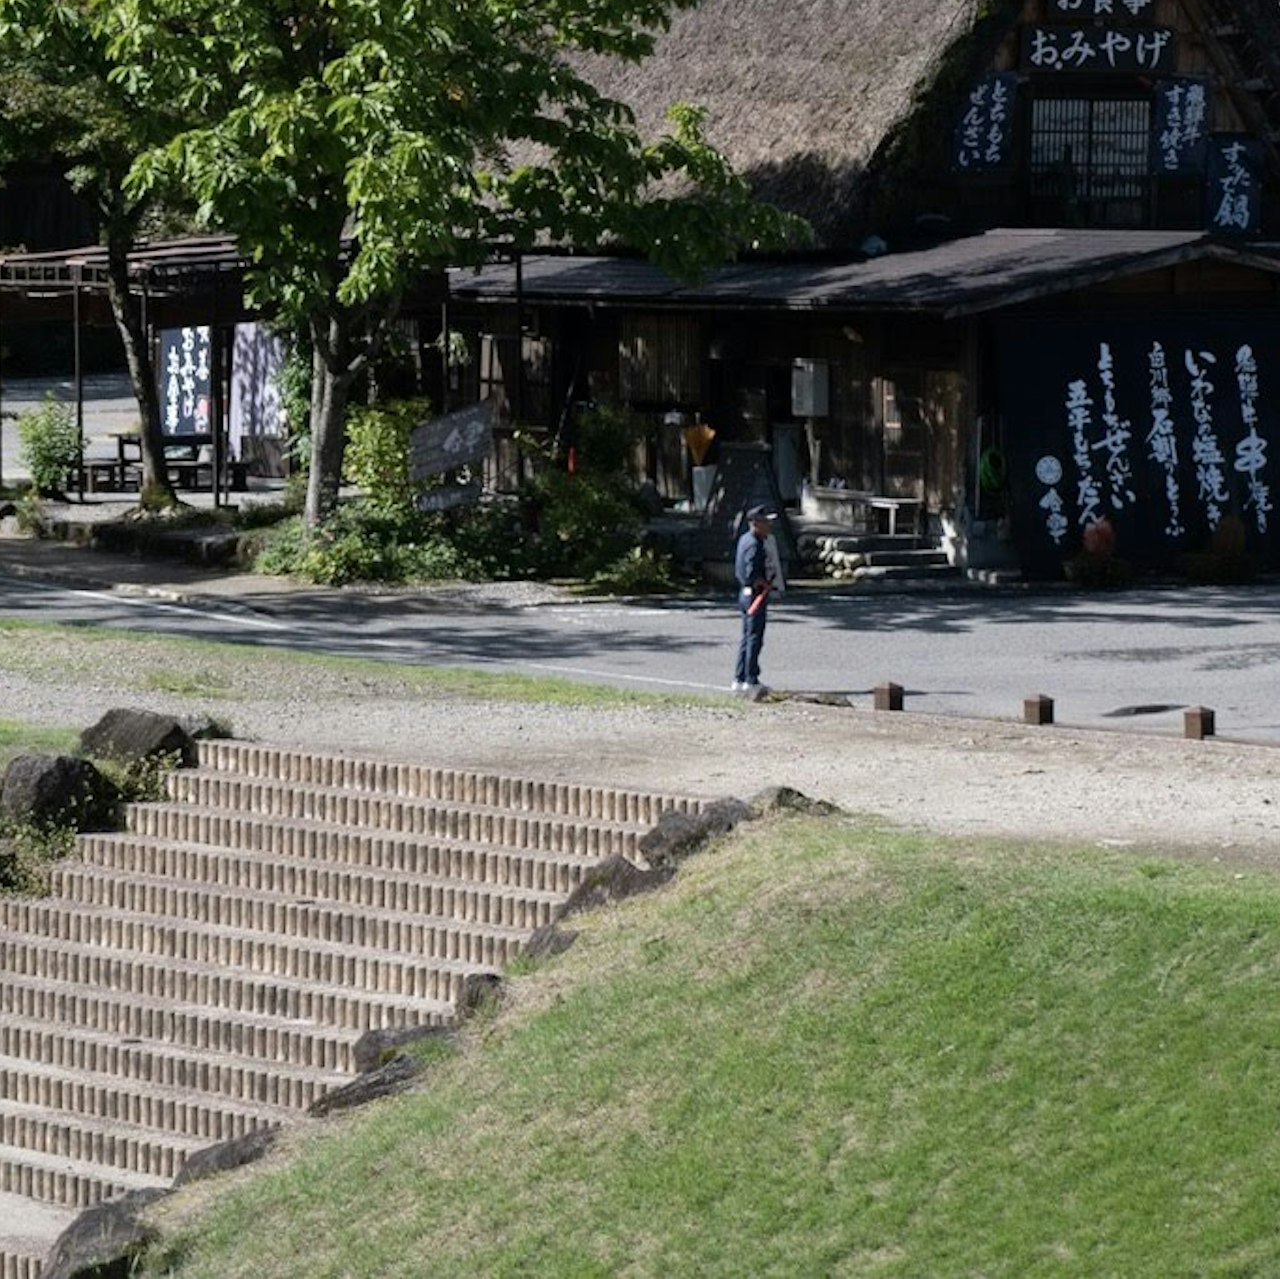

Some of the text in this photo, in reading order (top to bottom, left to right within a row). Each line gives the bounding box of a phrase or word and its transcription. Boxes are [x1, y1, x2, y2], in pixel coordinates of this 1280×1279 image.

[1029, 28, 1173, 69] おみやげ
[958, 83, 990, 167] ぜんざい
[984, 79, 1008, 163] とちもち
[1159, 83, 1185, 171] すき焼き
